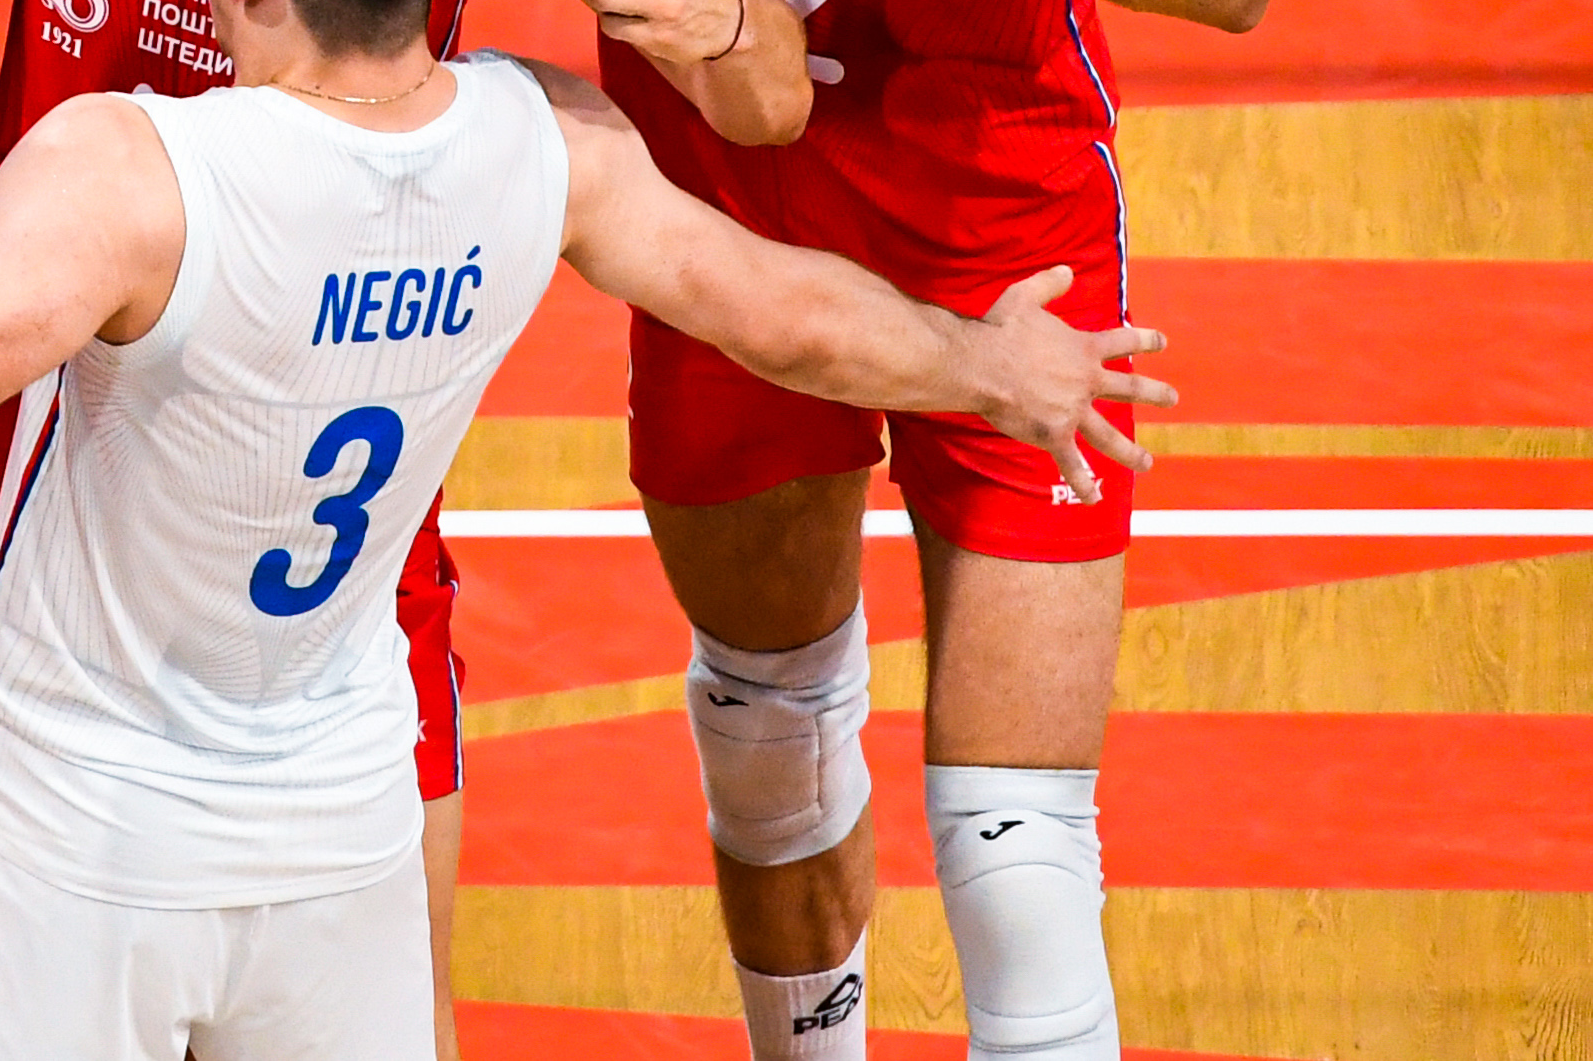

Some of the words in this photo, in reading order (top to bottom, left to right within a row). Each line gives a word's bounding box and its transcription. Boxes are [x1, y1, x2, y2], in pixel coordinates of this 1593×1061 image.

[41, 21, 82, 59] 1921
[312, 245, 483, 346] NEGIĆ
[249, 406, 405, 618] 3
